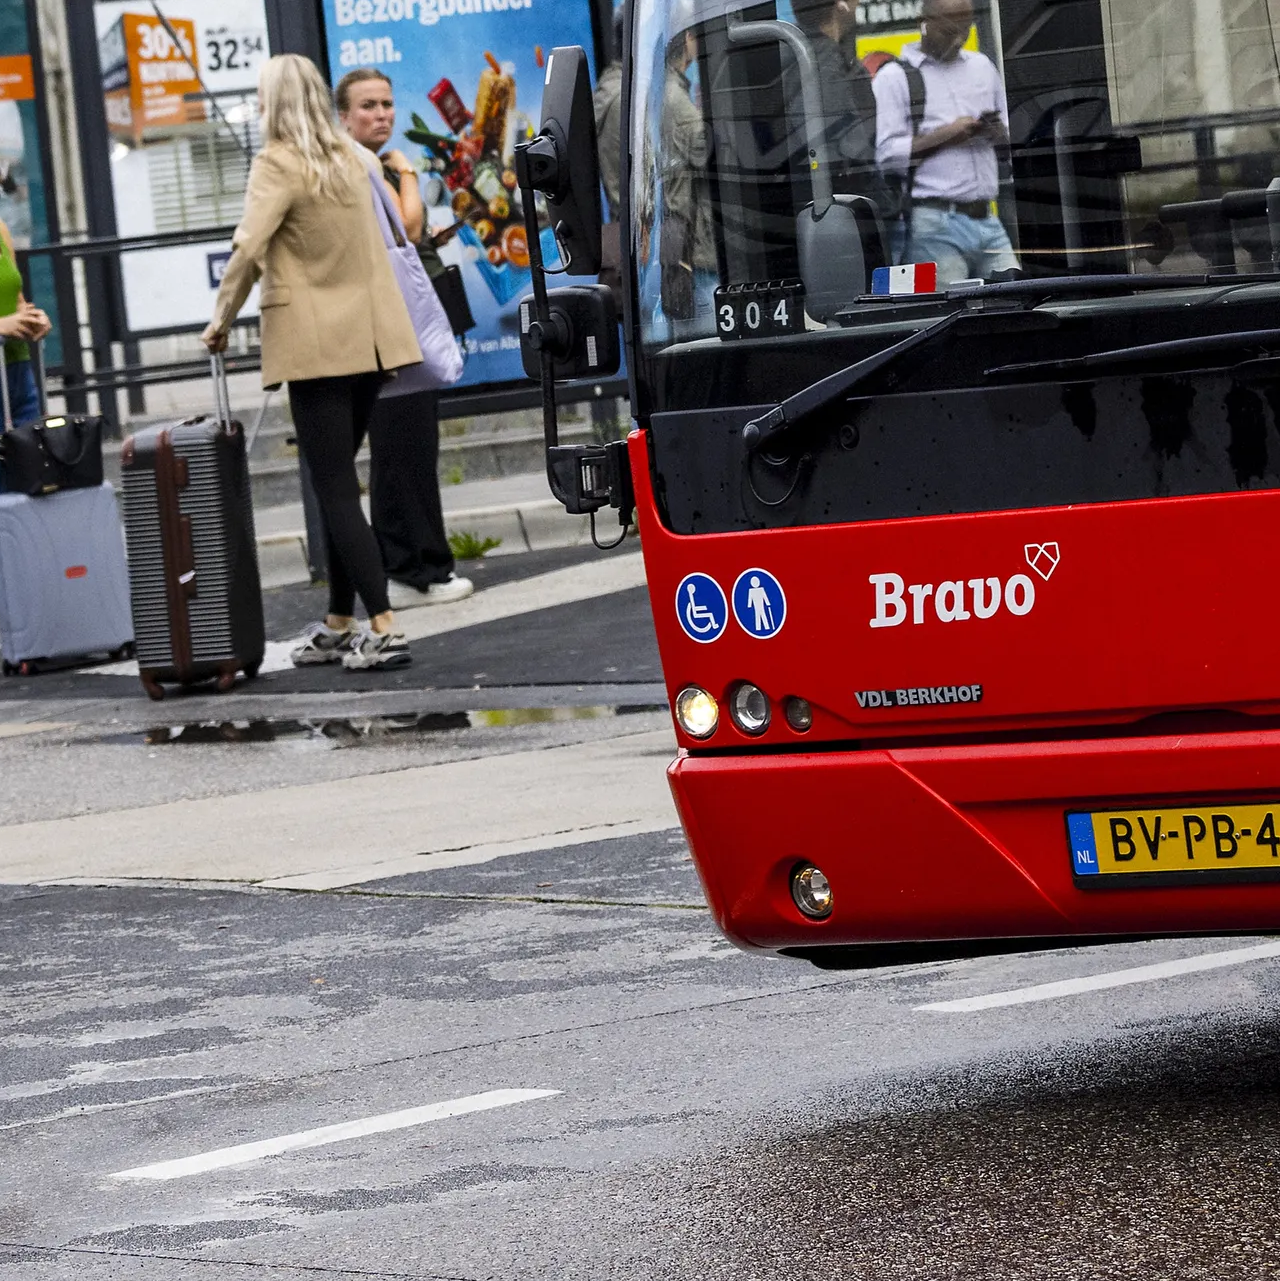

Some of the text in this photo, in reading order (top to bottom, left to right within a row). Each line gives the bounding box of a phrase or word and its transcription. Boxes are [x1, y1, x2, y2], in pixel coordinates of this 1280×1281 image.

[137, 23, 193, 60] 30%
[339, 36, 402, 66] aan.
[868, 572, 1036, 629] Bravo
[853, 683, 983, 710] VDL BERKHOF
[1076, 847, 1096, 868] NL
